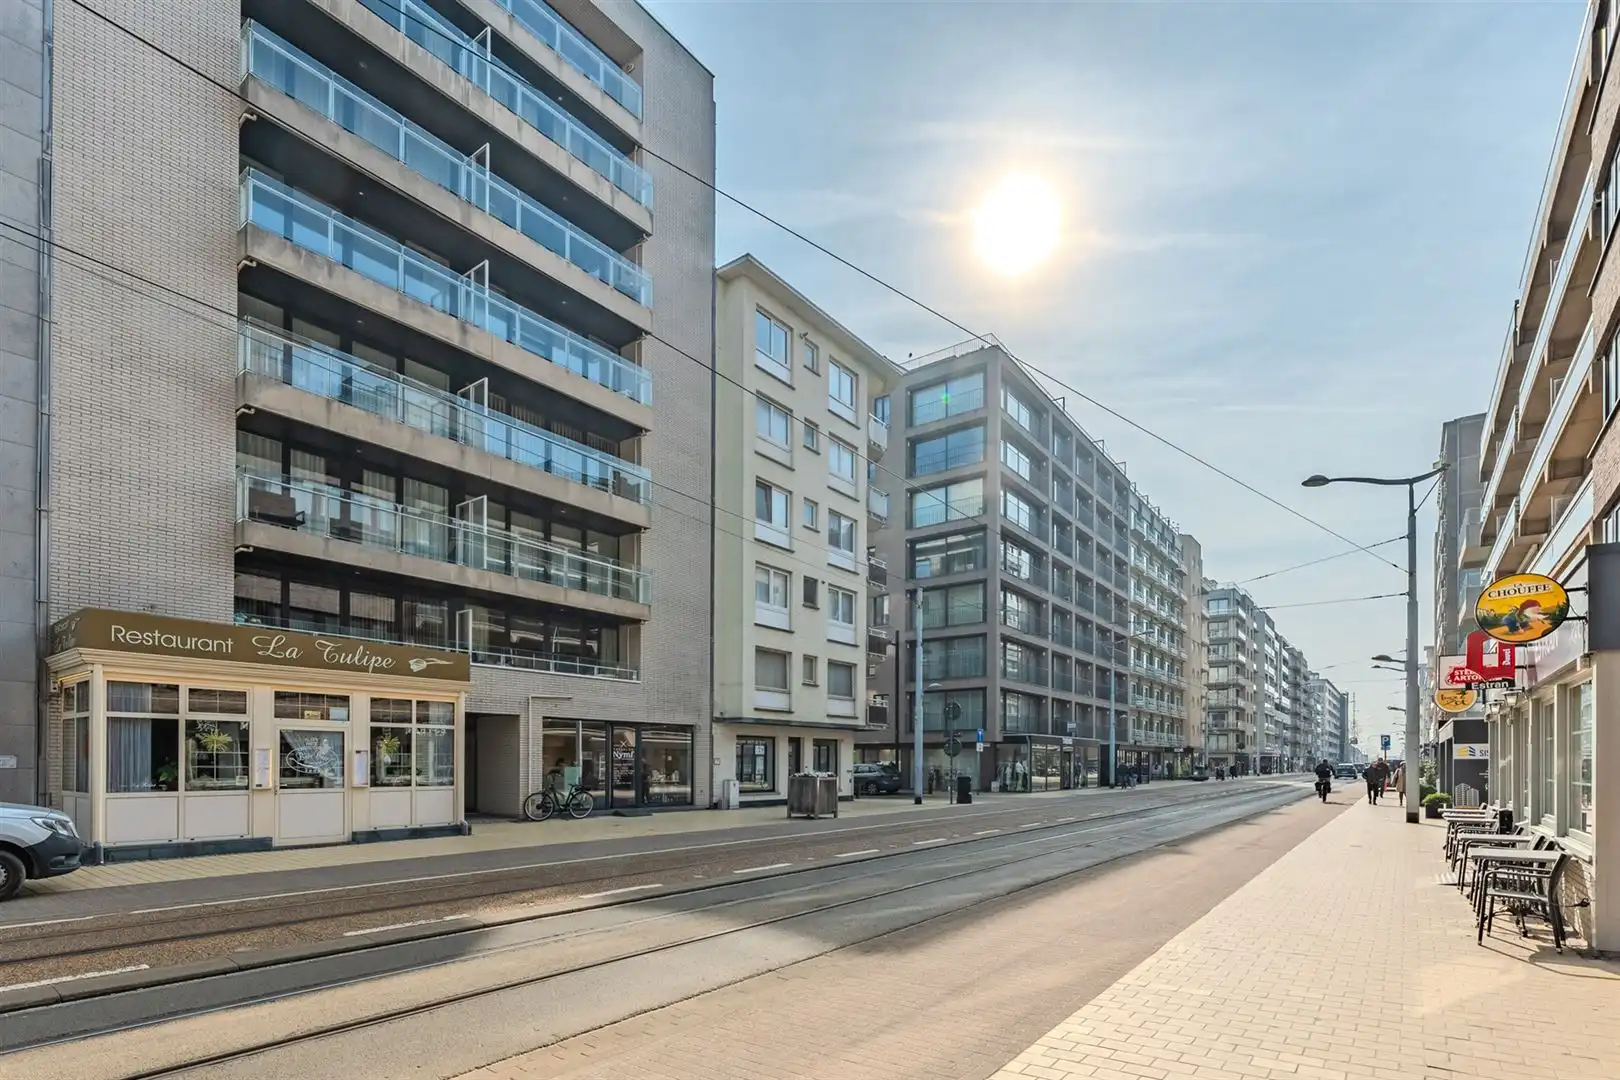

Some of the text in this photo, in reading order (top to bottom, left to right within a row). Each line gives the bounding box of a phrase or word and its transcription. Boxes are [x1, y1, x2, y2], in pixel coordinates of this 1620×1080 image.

[1487, 583, 1552, 599] CHOUFFE
[111, 624, 234, 654] Restaurant
[251, 634, 304, 660] La
[314, 639, 397, 675] Tulipe
[1471, 681, 1509, 690] Estran
[612, 750, 636, 760] Nymf
